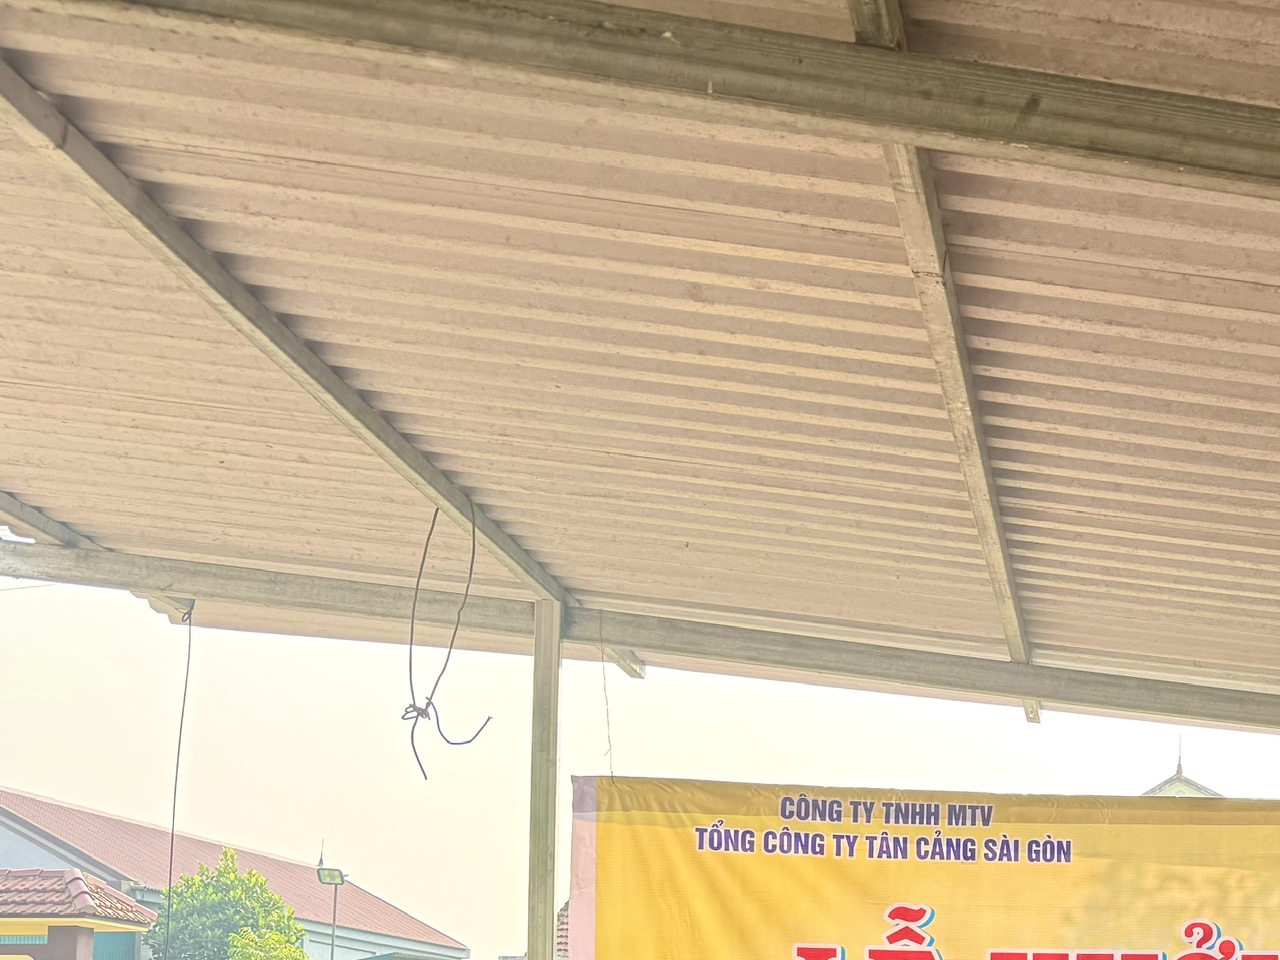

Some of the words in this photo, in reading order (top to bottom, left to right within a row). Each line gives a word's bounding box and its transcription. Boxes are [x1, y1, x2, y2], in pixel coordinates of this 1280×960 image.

[780, 793, 843, 823] CÔNG
[850, 800, 876, 824] TY
[882, 802, 940, 826] TNHH
[947, 804, 993, 827] MTV
[695, 819, 755, 853] TỔNG
[763, 826, 825, 856] CÔNG
[832, 834, 859, 857] TY
[865, 831, 908, 860] TÂN
[916, 829, 976, 861] CẢNG
[983, 834, 1020, 862] SÀI
[1027, 834, 1072, 863] GÒN
